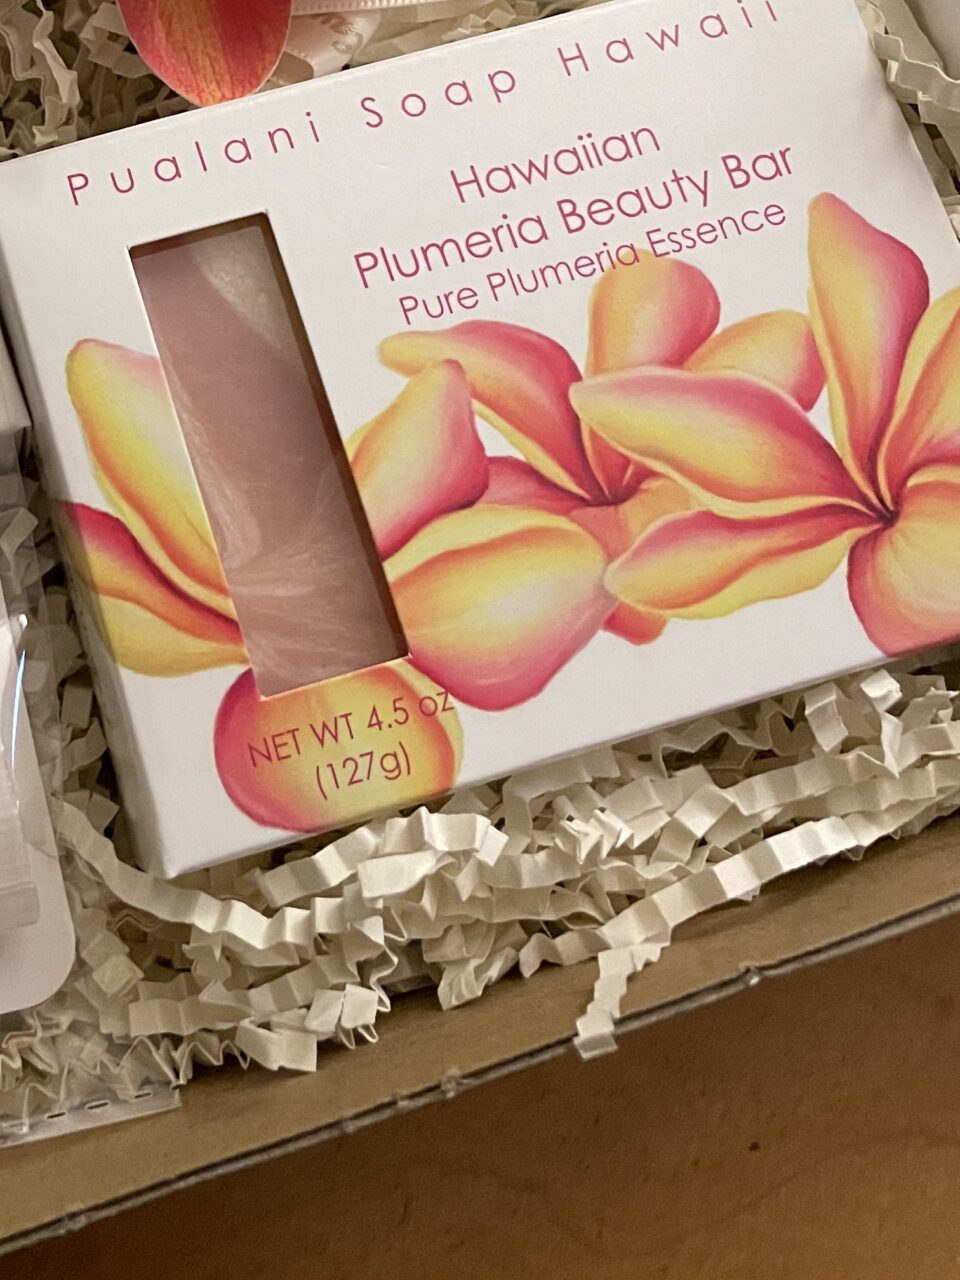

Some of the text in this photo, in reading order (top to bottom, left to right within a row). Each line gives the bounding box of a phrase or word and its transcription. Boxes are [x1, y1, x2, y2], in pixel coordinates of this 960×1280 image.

[66, 112, 322, 206] Pualani
[360, 64, 517, 129] Soap
[450, 122, 662, 204] Hawaiian
[353, 144, 795, 289] Plumeria Beauty Bar
[398, 200, 788, 326] Pure Plumeria Essence
[247, 727, 301, 768] NET
[309, 712, 354, 748] WT
[367, 697, 410, 731] 4.5
[315, 741, 412, 801] (127g)
